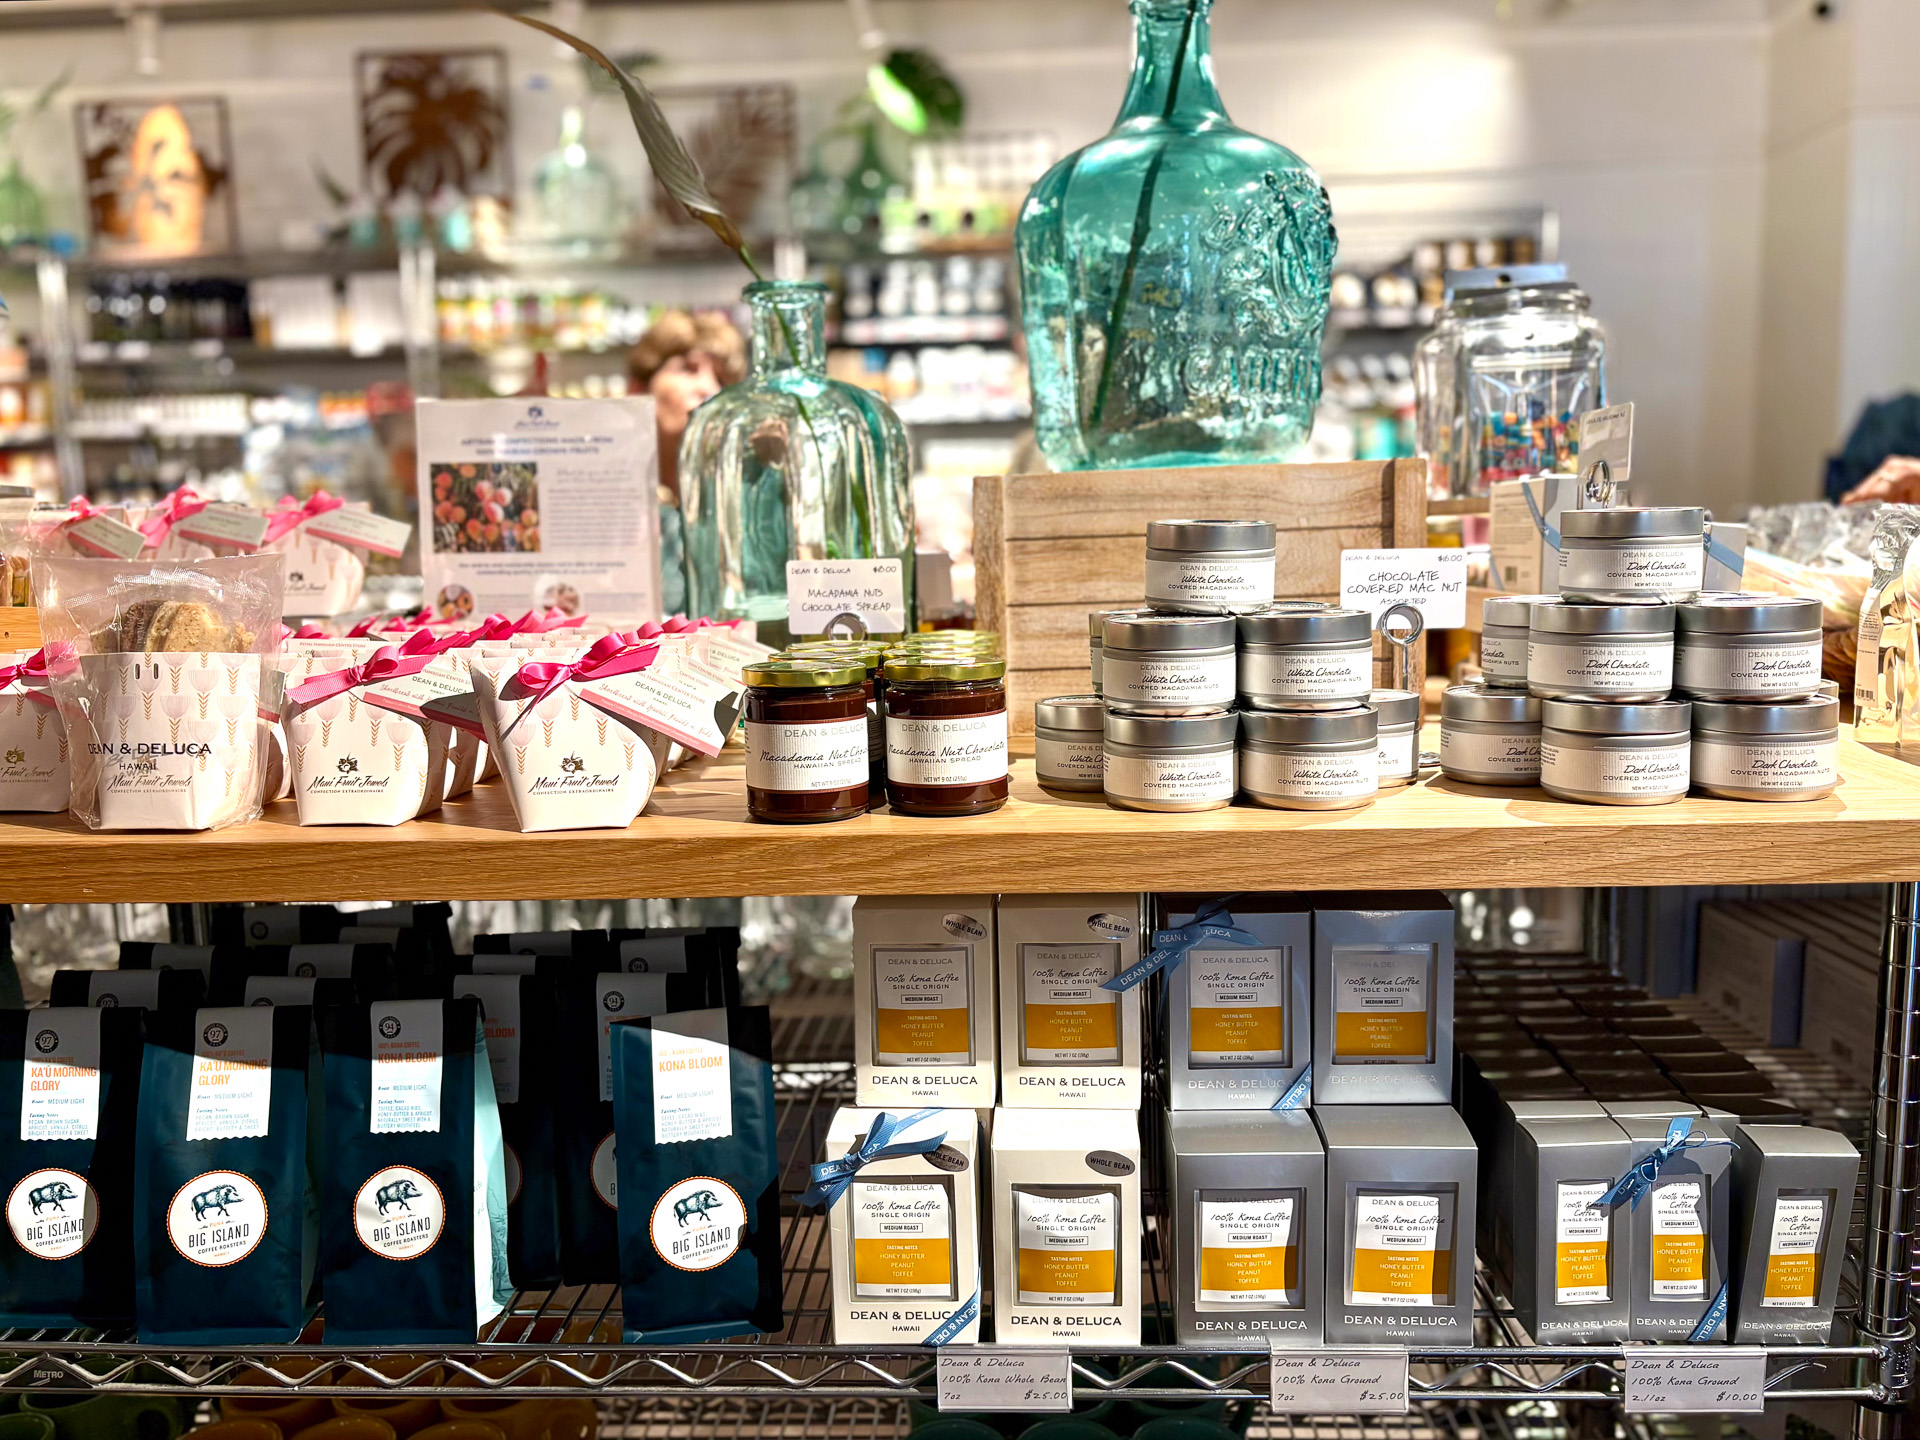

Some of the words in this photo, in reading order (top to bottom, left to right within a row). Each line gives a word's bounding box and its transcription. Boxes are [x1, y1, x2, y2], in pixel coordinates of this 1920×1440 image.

[1437, 554, 1463, 562] $16.00
[791, 567, 811, 575] DEAN
[1368, 570, 1440, 582] CHOCOLATE
[1181, 575, 1206, 584] White
[1207, 574, 1245, 584] Chocolate
[808, 588, 859, 598] MACADAMIA
[863, 588, 884, 598] NUTS
[1347, 583, 1404, 594] COVERED
[1409, 582, 1436, 593] MAC
[1441, 581, 1462, 592] NUT
[801, 602, 852, 612] CHOCOLATE
[856, 601, 891, 611] SPREAD
[1380, 597, 1427, 605] ASSORTED
[412, 675, 432, 687] DEAN
[634, 680, 655, 694] DEAN
[662, 691, 692, 710] DELUCA
[784, 728, 817, 738] DEAN
[820, 728, 828, 736] &
[831, 723, 865, 736] DELUCA
[901, 723, 930, 733] DEAN
[932, 723, 941, 732] &
[943, 721, 987, 732] DELUCA
[88, 743, 114, 755] DEAN
[119, 743, 132, 755] &
[137, 743, 212, 755] DELUCA
[940, 745, 963, 757] Nut
[966, 741, 1005, 755] Chocolate
[759, 749, 824, 762] Macadamia
[828, 749, 850, 761] Nut
[950, 755, 982, 764] SPREAD
[119, 762, 158, 771] HAWAII
[793, 762, 835, 770] HAWAIIAN
[837, 757, 862, 767] SPREAD
[1751, 759, 1778, 769] Dark
[1778, 759, 1818, 769] Chocolate
[107, 775, 134, 791] Maui
[135, 774, 160, 788] Fruit
[160, 775, 192, 788] Jewels
[306, 776, 334, 792] Maui
[334, 775, 359, 788] Fruit
[359, 776, 390, 788] Jewels
[528, 776, 559, 794] Maui
[559, 774, 588, 788] Fruit
[587, 774, 620, 787] Jewels
[209, 1029, 221, 1039] 97
[41, 1036, 52, 1045] 97
[378, 1052, 403, 1064] KONA
[405, 1051, 437, 1063] BLOOM
[659, 1059, 686, 1072] KONA
[688, 1055, 723, 1070] BLOOM
[223, 1059, 268, 1071] MORNING
[53, 1066, 97, 1078] MORNING
[30, 1080, 60, 1092] GLORY
[198, 1074, 230, 1086] GLORY
[872, 1075, 908, 1085] DEAN
[912, 1075, 921, 1085] &
[924, 1075, 978, 1085] DELUCA
[1019, 1076, 1056, 1086] DEAN
[1059, 1077, 1068, 1086] &
[1072, 1077, 1126, 1087] DELUCA
[1090, 1156, 1112, 1168] WHOLE
[1113, 1161, 1131, 1171] BEAN
[1027, 1213, 1050, 1223] 100%
[1054, 1213, 1077, 1223] Kona
[1079, 1213, 1107, 1224] Coffee
[26, 1226, 43, 1241] BIG
[48, 1218, 84, 1238] ISLAND
[373, 1226, 390, 1242] BIG
[395, 1216, 431, 1237] ISLAND
[35, 1240, 54, 1248] COFFEE
[55, 1234, 82, 1245] ROASTERS
[188, 1233, 206, 1248] BIG
[212, 1223, 249, 1244] ISLAND
[383, 1239, 402, 1248] COFFEE
[403, 1233, 429, 1243] ROASTERS
[672, 1238, 690, 1255] BIG
[695, 1226, 731, 1249] ISLAND
[197, 1246, 218, 1255] COFFEE
[219, 1240, 247, 1251] ROASTERS
[682, 1250, 701, 1260] COFFEE
[702, 1243, 729, 1255] ROASTERS
[1011, 1316, 1049, 1325] DEAN
[1053, 1316, 1062, 1325] &
[1066, 1316, 1122, 1326] DELUCA
[1195, 1321, 1234, 1330] DEAN
[1238, 1321, 1247, 1330] &
[1251, 1320, 1308, 1330] DELUCA
[1344, 1315, 1383, 1325] DEAN
[1387, 1316, 1396, 1325] &
[1400, 1316, 1458, 1326] DELUCA
[941, 1358, 969, 1367] Dean
[973, 1357, 982, 1367] &
[987, 1357, 1025, 1367] Deluca
[1274, 1358, 1304, 1367] Dean
[1308, 1358, 1317, 1367] &
[1322, 1358, 1361, 1367] Deluca
[1631, 1360, 1661, 1369] Dean
[1665, 1359, 1675, 1369] &
[1680, 1360, 1720, 1369] Deluca
[33, 1369, 64, 1379] METRO
[942, 1374, 971, 1384] 100%
[976, 1374, 1001, 1384] Kona
[1005, 1374, 1035, 1384] Whole
[1040, 1374, 1067, 1383] Bean
[1276, 1374, 1306, 1385] 100%
[1310, 1374, 1336, 1384] Kona
[1340, 1374, 1382, 1384] Ground
[1631, 1376, 1662, 1386] 100%
[1667, 1376, 1692, 1386] Kona
[1698, 1376, 1740, 1386] Ground
[944, 1392, 961, 1400] 7oz
[1024, 1389, 1068, 1401] $25.00
[1277, 1393, 1295, 1401] 7oz
[1359, 1390, 1404, 1401] $25.00
[1631, 1394, 1666, 1402] 2.11oz
[1716, 1391, 1758, 1402] $10.00
